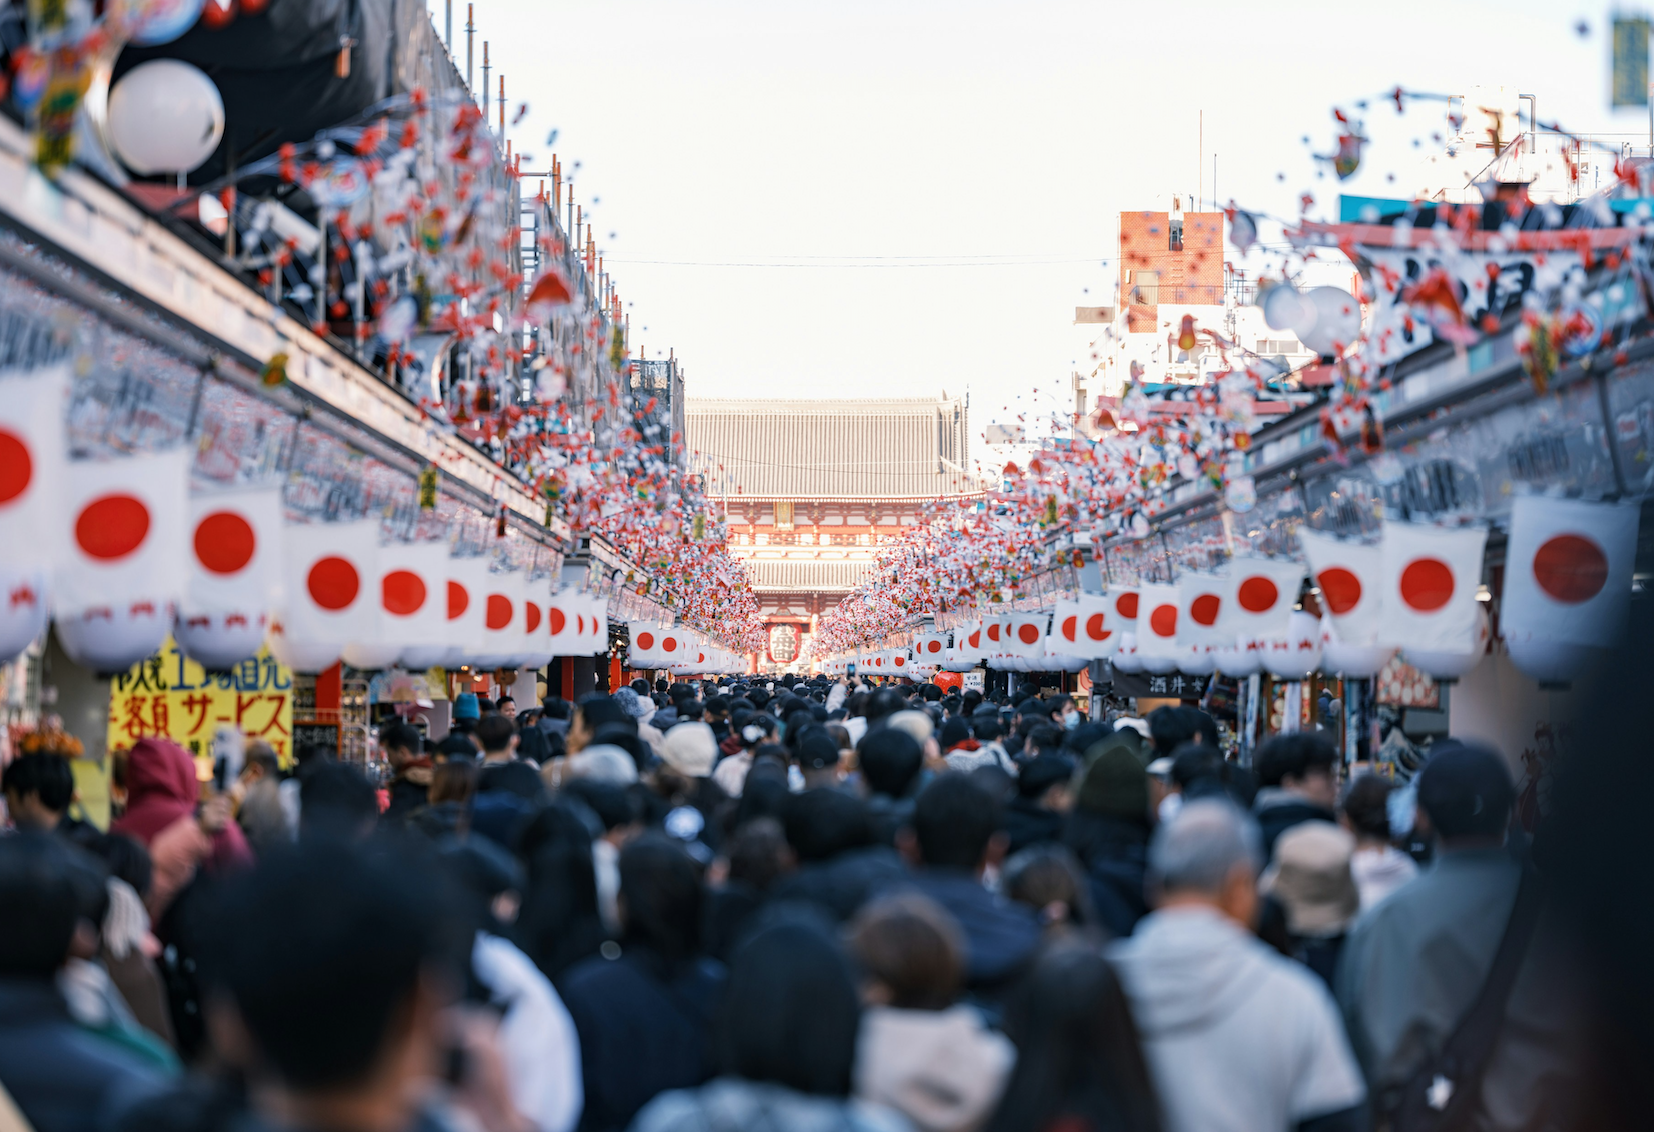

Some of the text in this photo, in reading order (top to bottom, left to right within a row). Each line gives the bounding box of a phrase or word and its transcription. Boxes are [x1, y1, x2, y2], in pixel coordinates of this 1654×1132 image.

[772, 623, 796, 661] 小舟町
[110, 693, 290, 740] 額サービス
